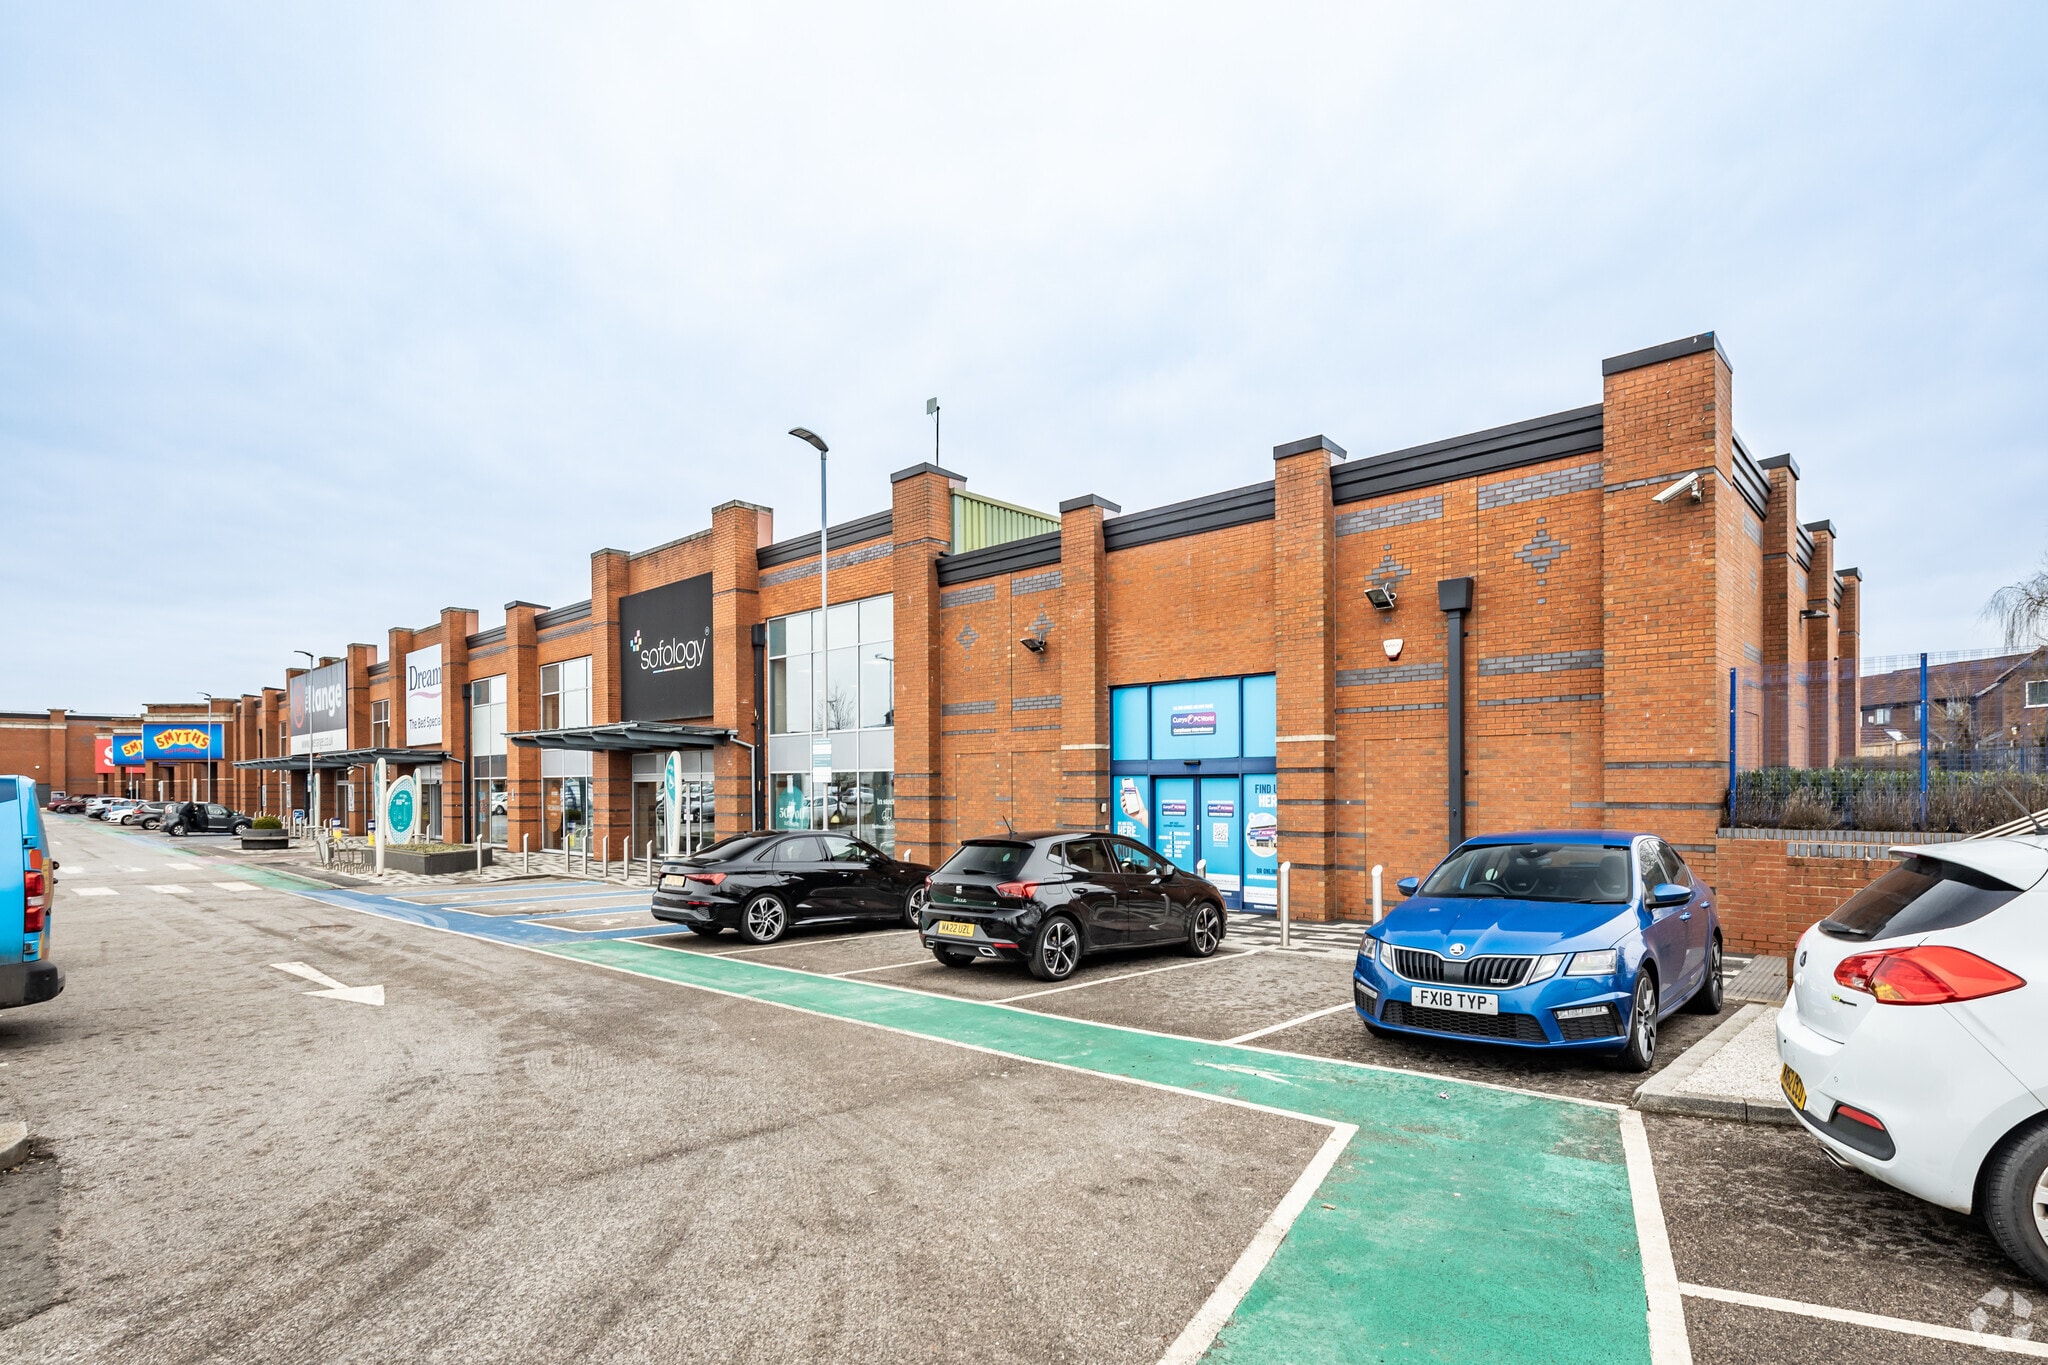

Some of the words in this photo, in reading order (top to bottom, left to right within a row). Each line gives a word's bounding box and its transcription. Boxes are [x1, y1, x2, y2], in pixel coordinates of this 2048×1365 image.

[641, 638, 706, 669] sofology
[409, 666, 442, 691] Dream
[155, 731, 210, 748] SMYTHS
[1255, 784, 1271, 794] FIND
[1420, 990, 1453, 1006] FX18
[1457, 994, 1487, 1010] TYP
